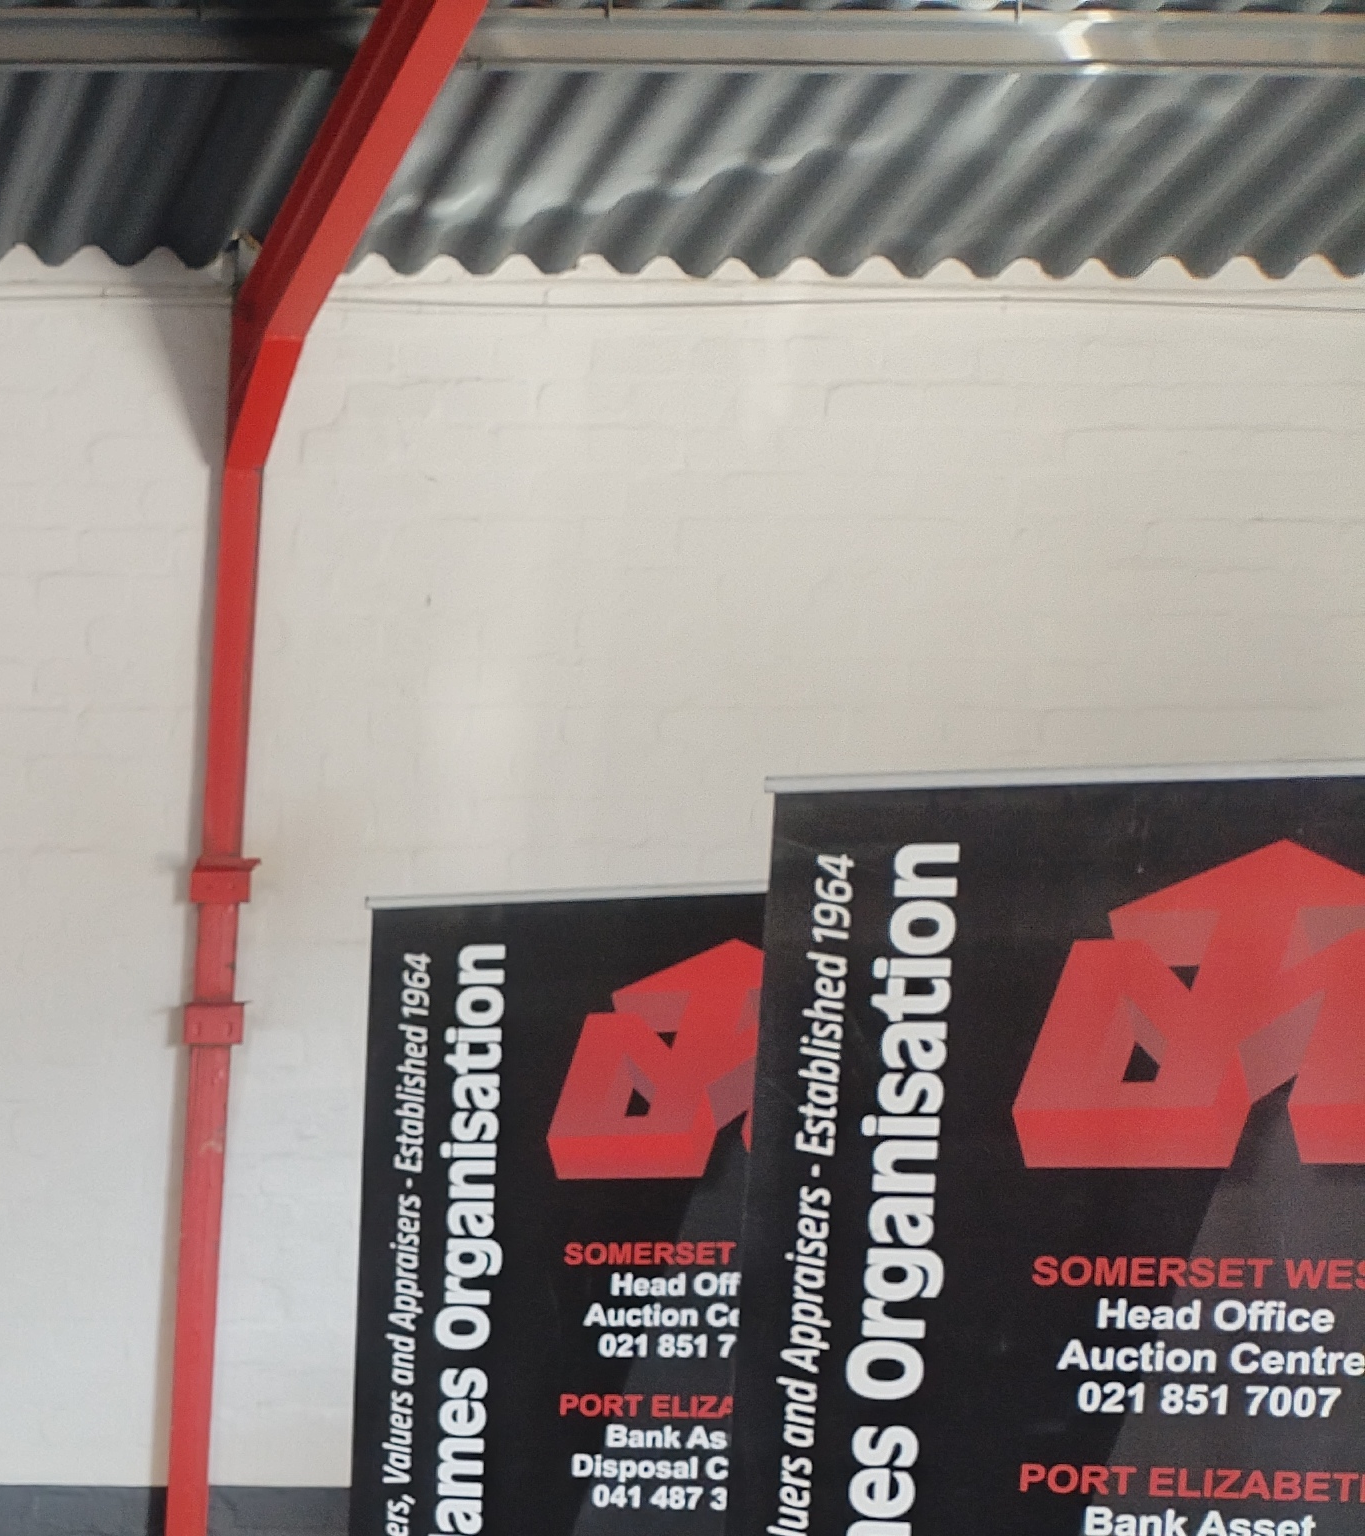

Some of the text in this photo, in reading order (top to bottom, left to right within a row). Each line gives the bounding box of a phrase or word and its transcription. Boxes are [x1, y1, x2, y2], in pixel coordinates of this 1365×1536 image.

[811, 853, 855, 943] 1964
[400, 952, 432, 1018] 1964
[794, 951, 848, 1157] Established
[393, 1023, 429, 1174] Established
[845, 842, 961, 1400] Organisation
[433, 943, 506, 1351] Organisation
[387, 1193, 425, 1332] Appraisers
[563, 1240, 737, 1266] SOMERSET
[610, 1271, 687, 1297] Head
[779, 1185, 832, 1374] Appraisers
[1031, 1255, 1277, 1290] SOMERSET
[582, 1302, 699, 1328] Auction
[1096, 1297, 1336, 1334] Head Office
[384, 1332, 416, 1386] and
[598, 1333, 648, 1358] 021
[656, 1333, 708, 1359] 851
[1056, 1339, 1365, 1377] Auction Centre
[559, 1393, 645, 1418] PORT
[775, 1375, 818, 1448] and
[1077, 1381, 1342, 1418] 021 851 7007
[381, 1389, 414, 1484] Valuers
[571, 1453, 699, 1484] Disposal
[1018, 1463, 1138, 1496] PORT
[591, 1483, 642, 1509] 041
[648, 1485, 704, 1511] 487
